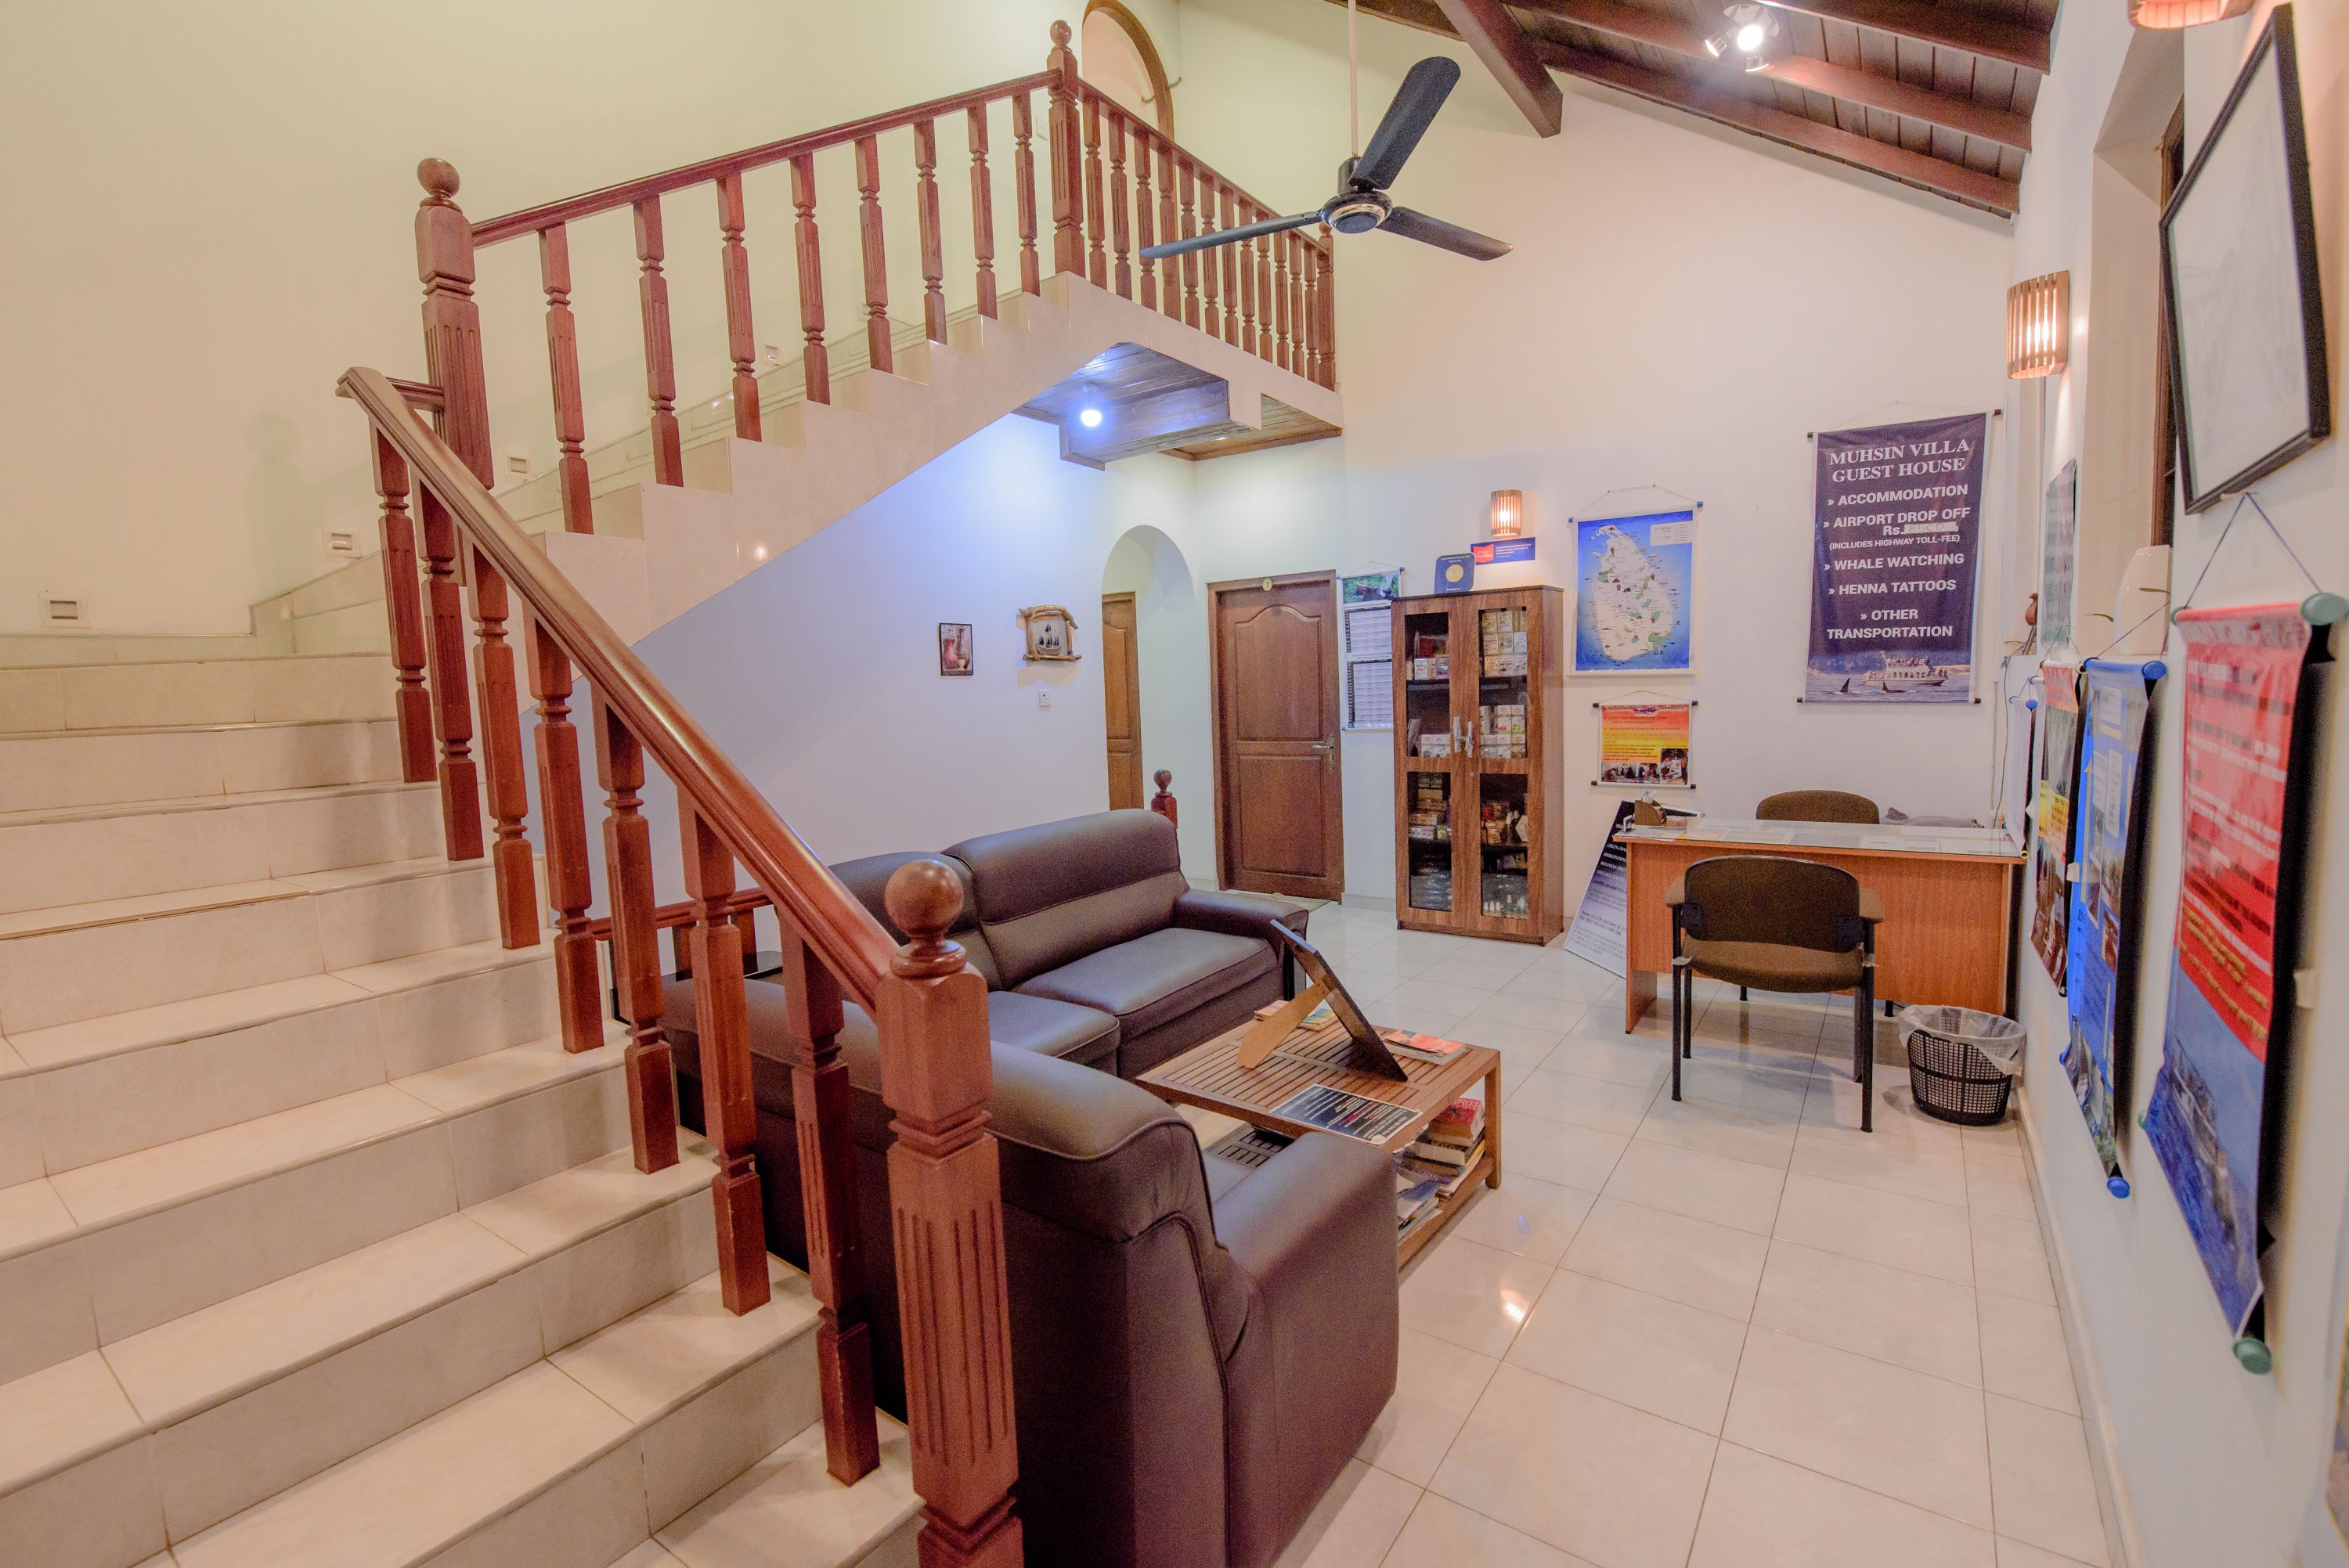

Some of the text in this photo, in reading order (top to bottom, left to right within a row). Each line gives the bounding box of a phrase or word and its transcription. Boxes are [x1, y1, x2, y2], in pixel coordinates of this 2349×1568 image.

[1829, 438, 1970, 466] MUHSIN VILLA
[1831, 457, 1965, 483] GUEST HOUSE
[1838, 484, 1968, 506] ACCOMMODATION
[1833, 506, 1971, 528] AIRPORT DROP OFF
[1882, 525, 1904, 536] Rs.
[1829, 534, 1960, 551] (INCLUDES HIGHWAY TOLL-FEE)
[1834, 553, 1965, 571] WHALE WATCHING
[1838, 579, 1957, 595] HENNA TATTOOS
[1871, 608, 1918, 621] OTHER
[1827, 625, 1953, 640] TRANSPORTATION
